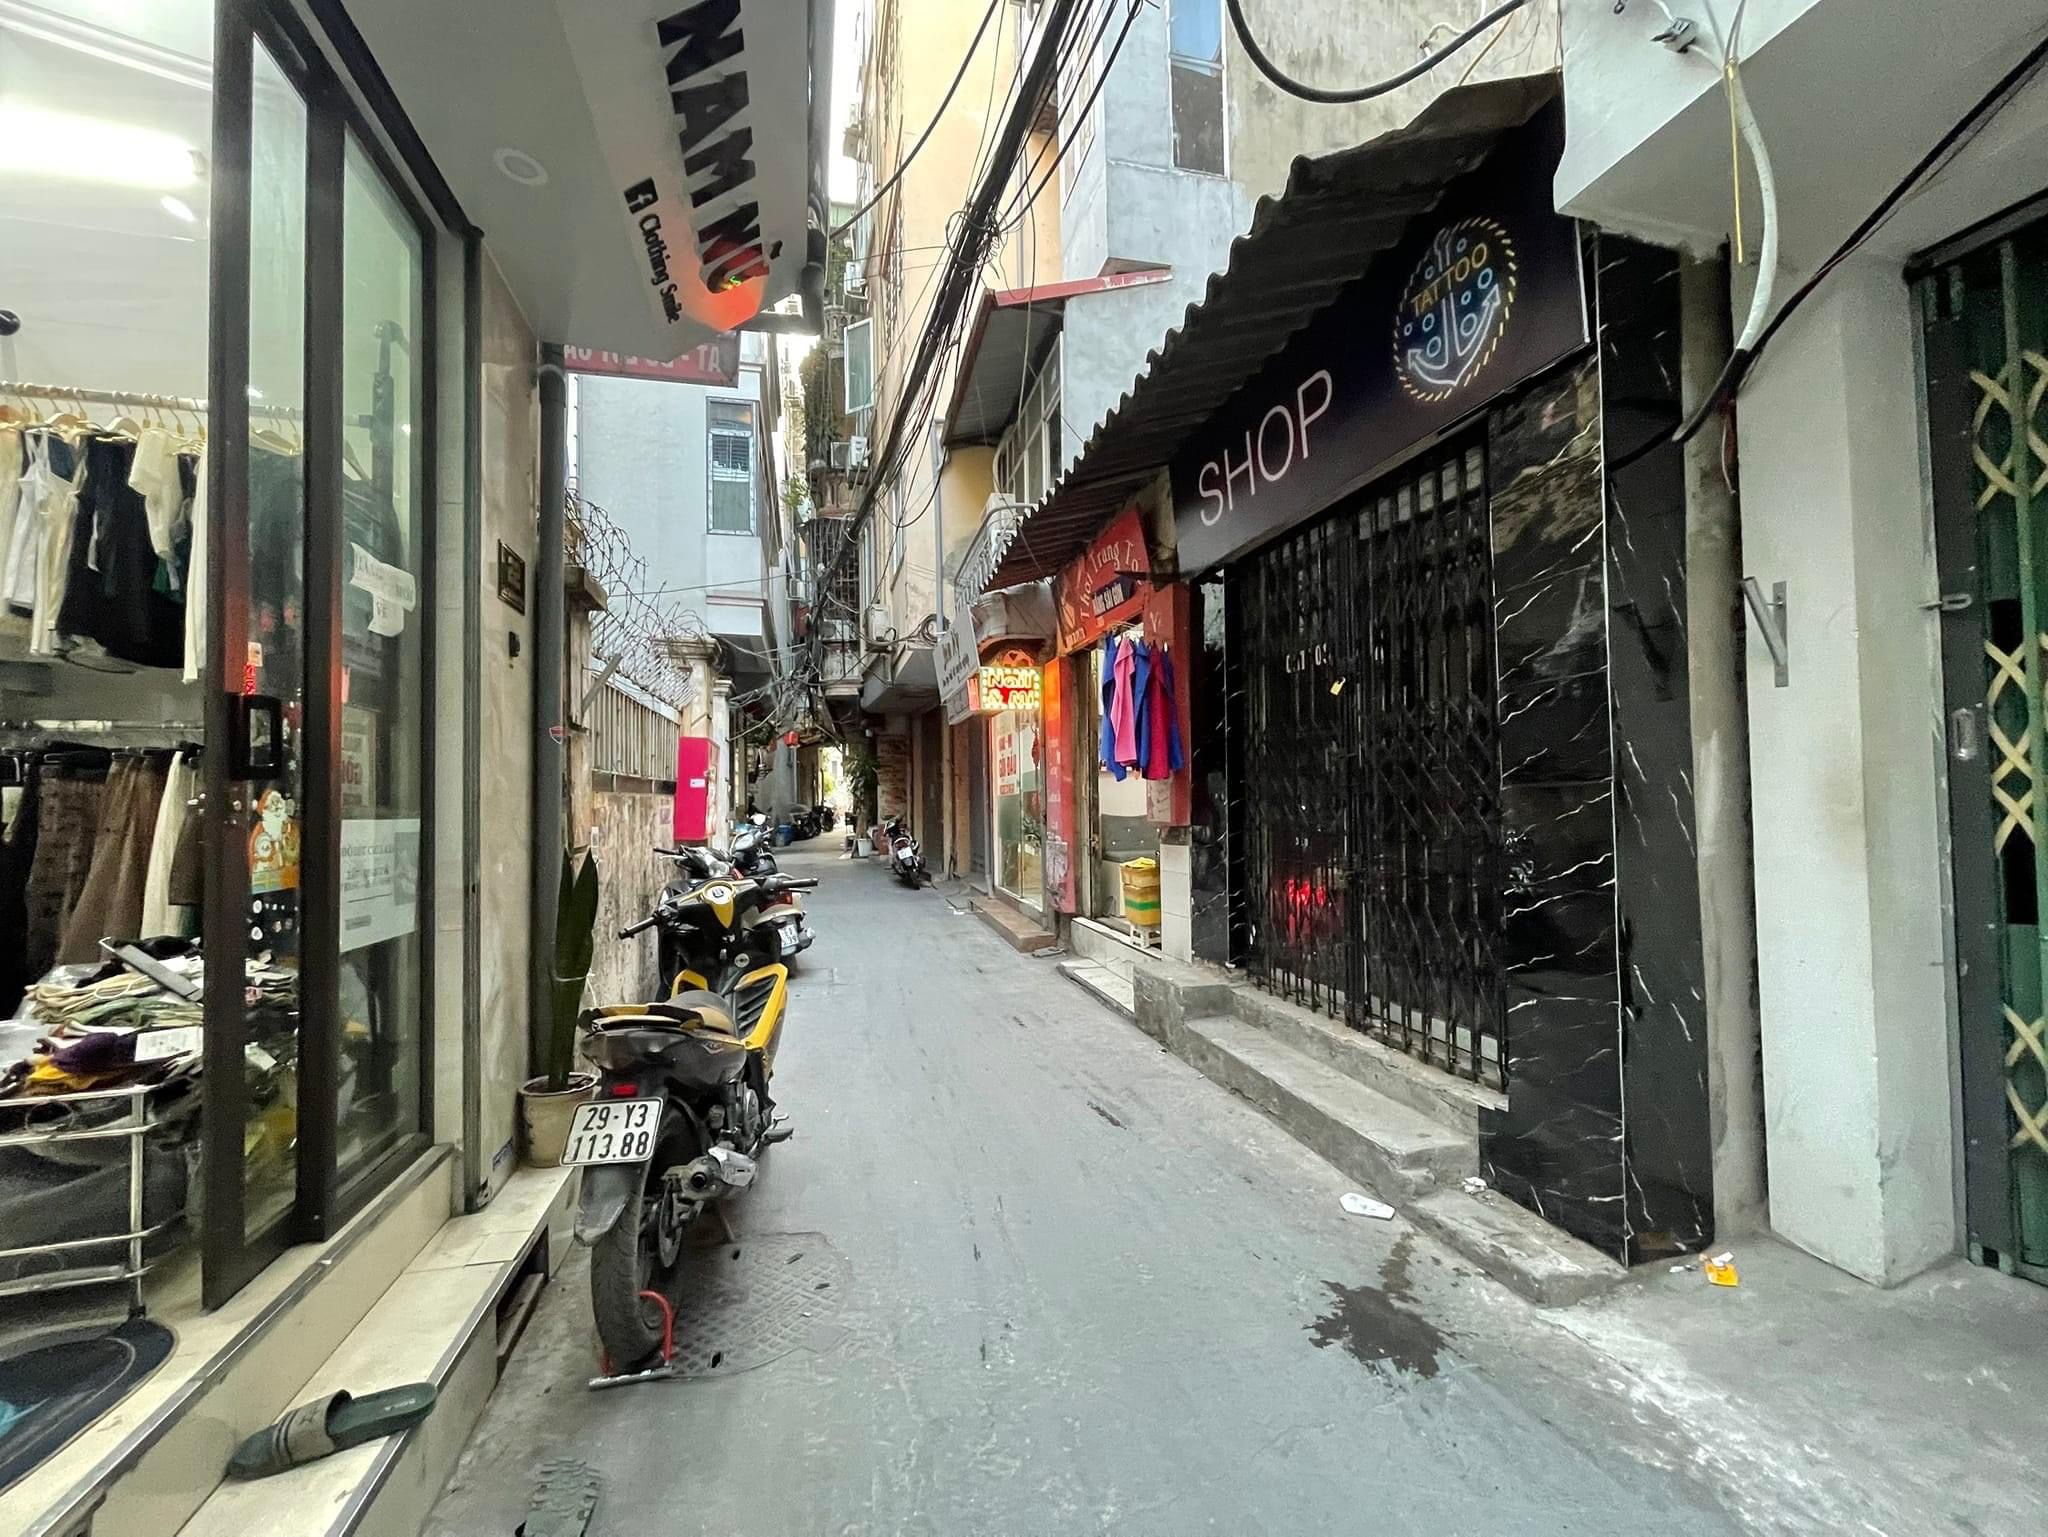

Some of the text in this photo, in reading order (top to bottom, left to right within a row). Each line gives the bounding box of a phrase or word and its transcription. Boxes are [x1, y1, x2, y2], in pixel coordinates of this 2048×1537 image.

[656, 0, 757, 208] NAM
[640, 213, 671, 286] Clothing
[1411, 243, 1487, 317] TATTOO
[1198, 369, 1333, 527] SHOP
[1088, 541, 1120, 573] Trang
[571, 1131, 650, 1162] 113.88
[583, 1104, 649, 1132] 29-Y3
